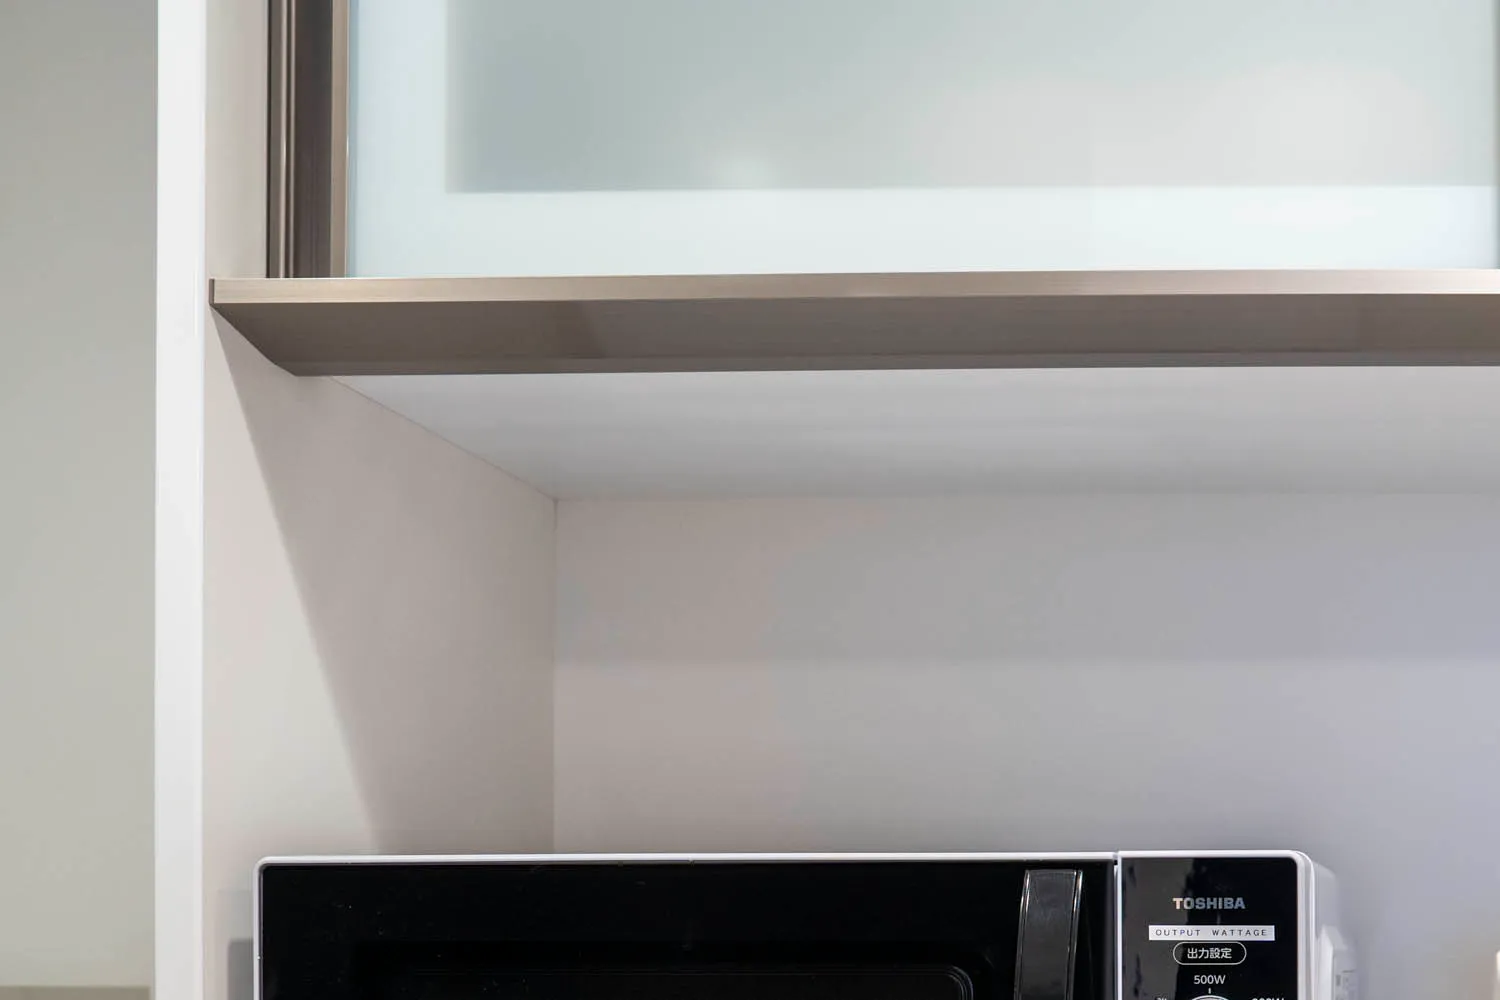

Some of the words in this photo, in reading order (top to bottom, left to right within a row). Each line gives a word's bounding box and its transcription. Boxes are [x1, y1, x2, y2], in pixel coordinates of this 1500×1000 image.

[1173, 897, 1246, 910] TOSHIBA
[1155, 929, 1201, 937] OUTPUT
[1212, 929, 1268, 937] WATTAGE
[1187, 947, 1232, 959] 出力設定
[1193, 975, 1226, 985] 500W
